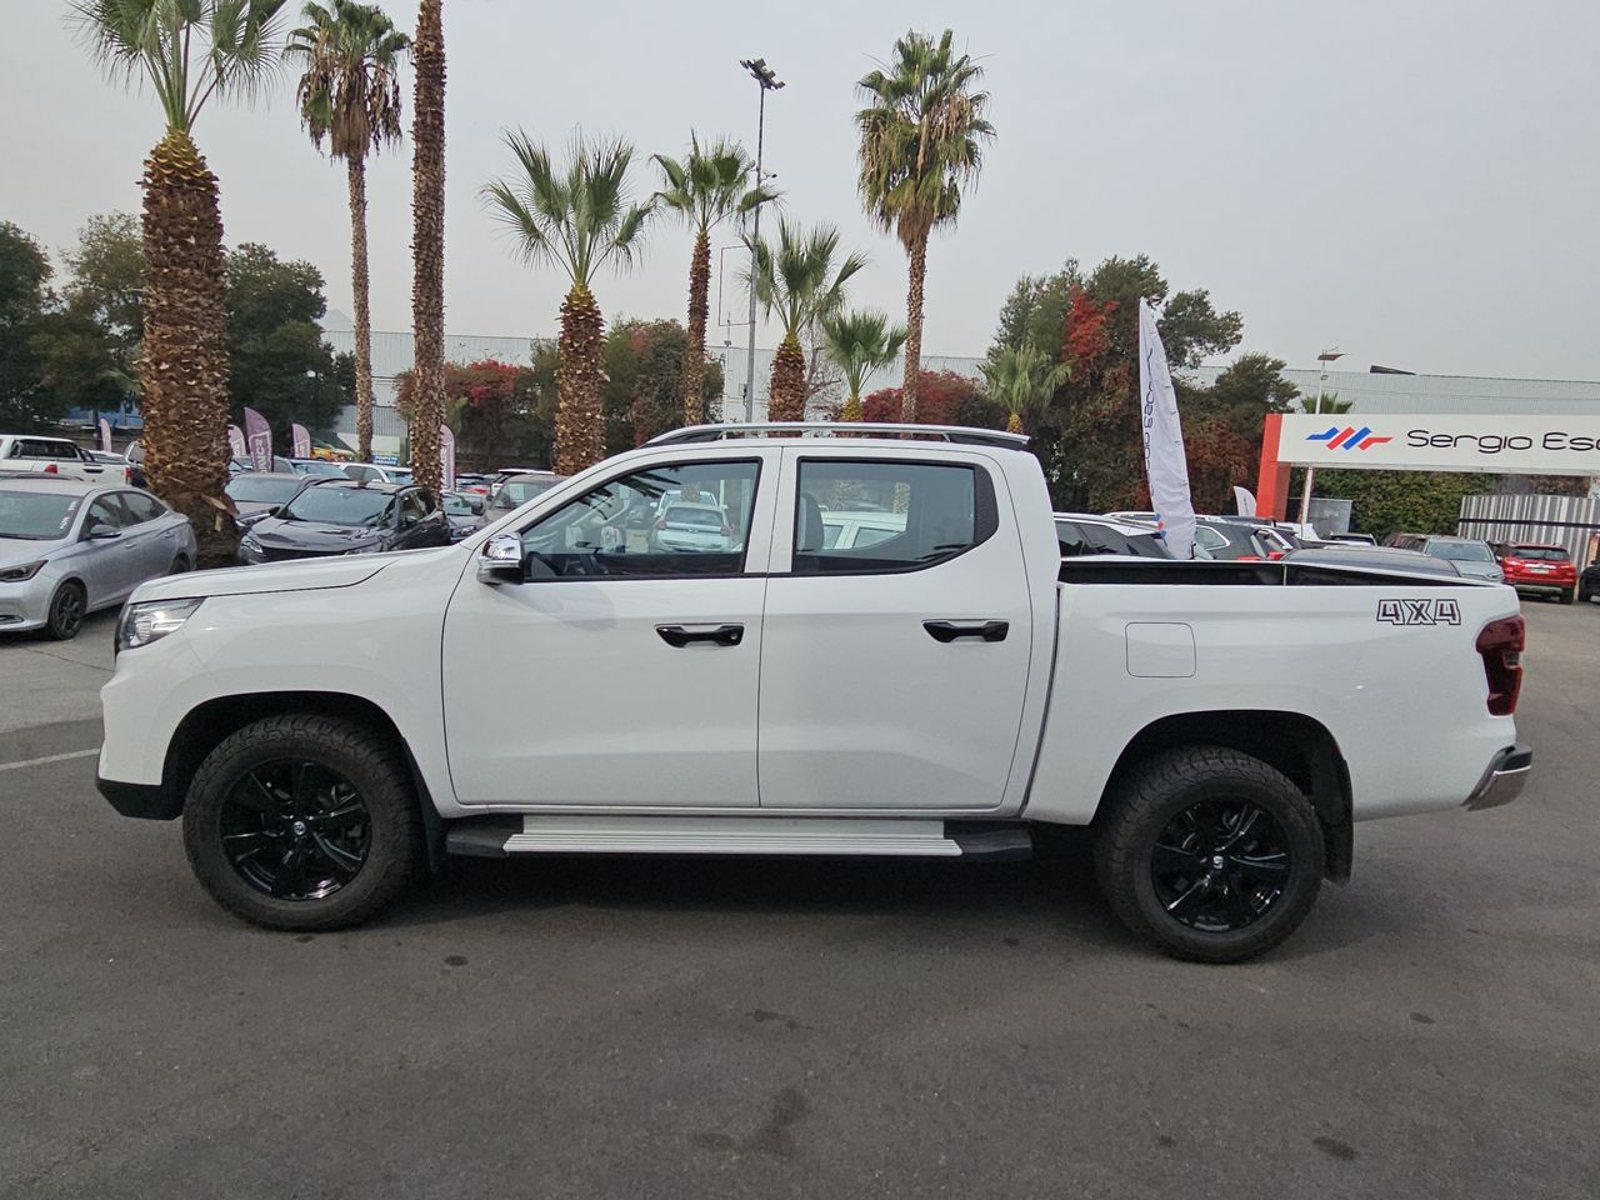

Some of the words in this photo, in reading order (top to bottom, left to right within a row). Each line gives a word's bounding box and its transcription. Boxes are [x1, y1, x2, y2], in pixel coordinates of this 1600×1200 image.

[1407, 429, 1533, 454] Sergio
[1542, 431, 1600, 452] Es
[1376, 599, 1461, 625] 4X4
